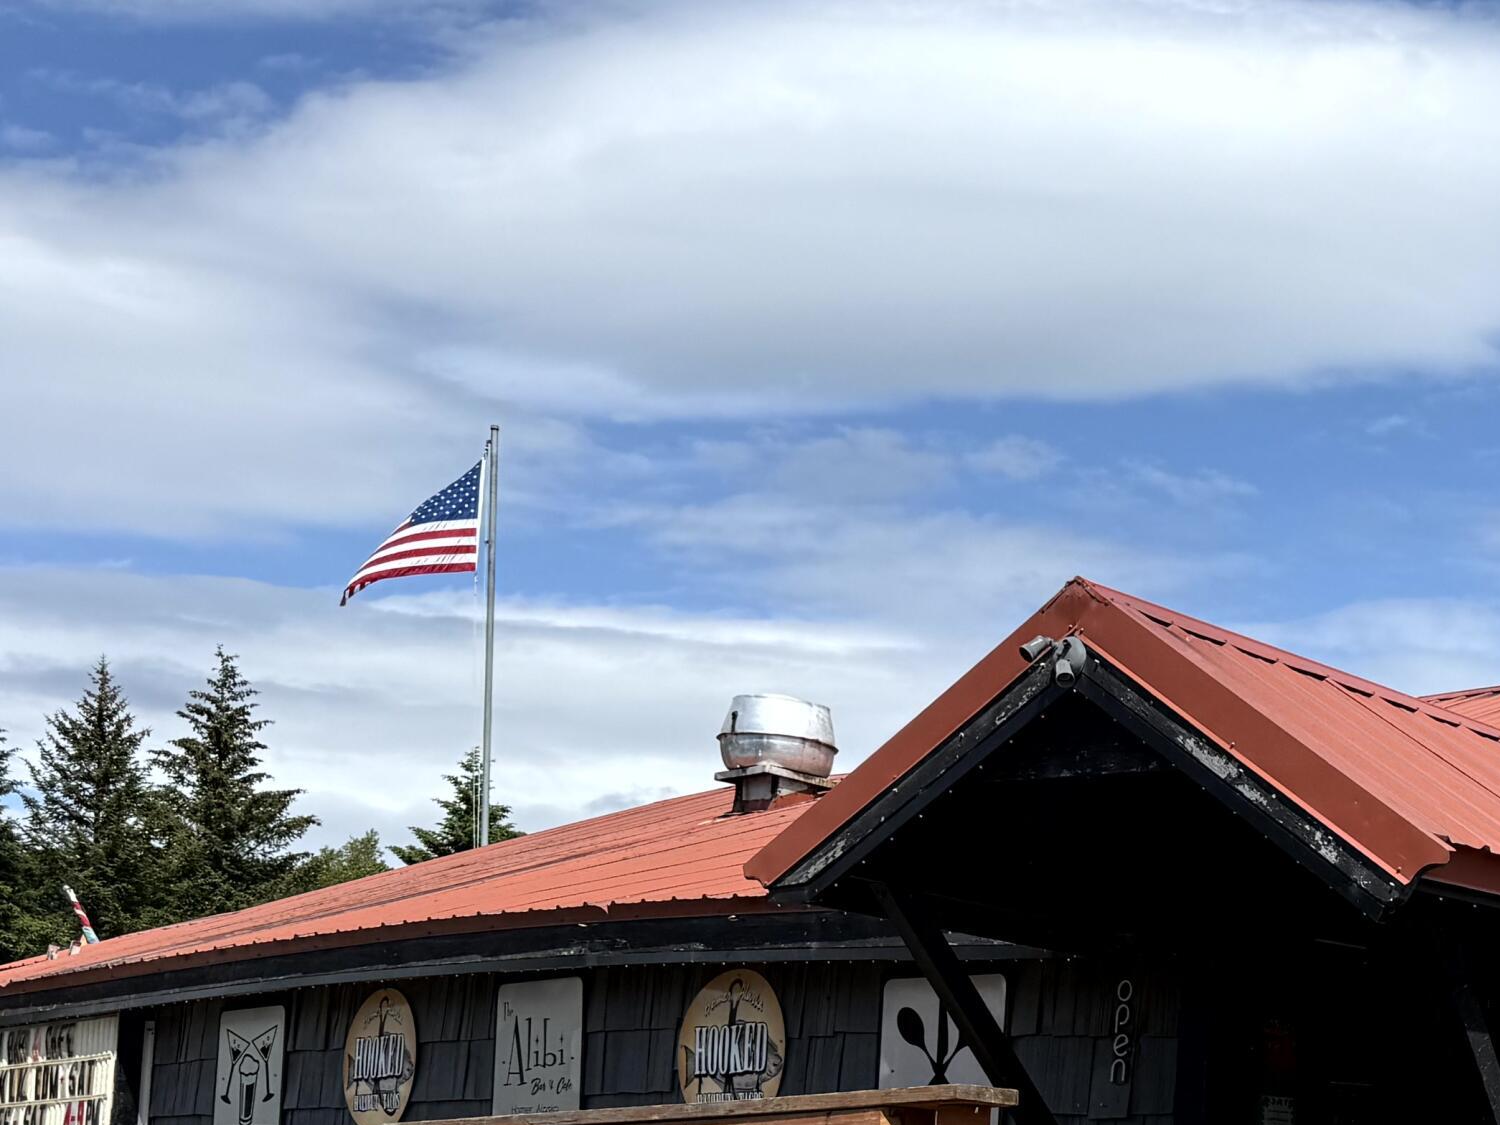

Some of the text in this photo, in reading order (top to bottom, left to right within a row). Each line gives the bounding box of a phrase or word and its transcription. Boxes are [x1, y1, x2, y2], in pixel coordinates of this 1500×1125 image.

[353, 1033, 405, 1080] HOOKED
[503, 1015, 567, 1086] Alibi
[694, 1022, 768, 1076] HOOKED
[69, 1059, 96, 1097] SAT
